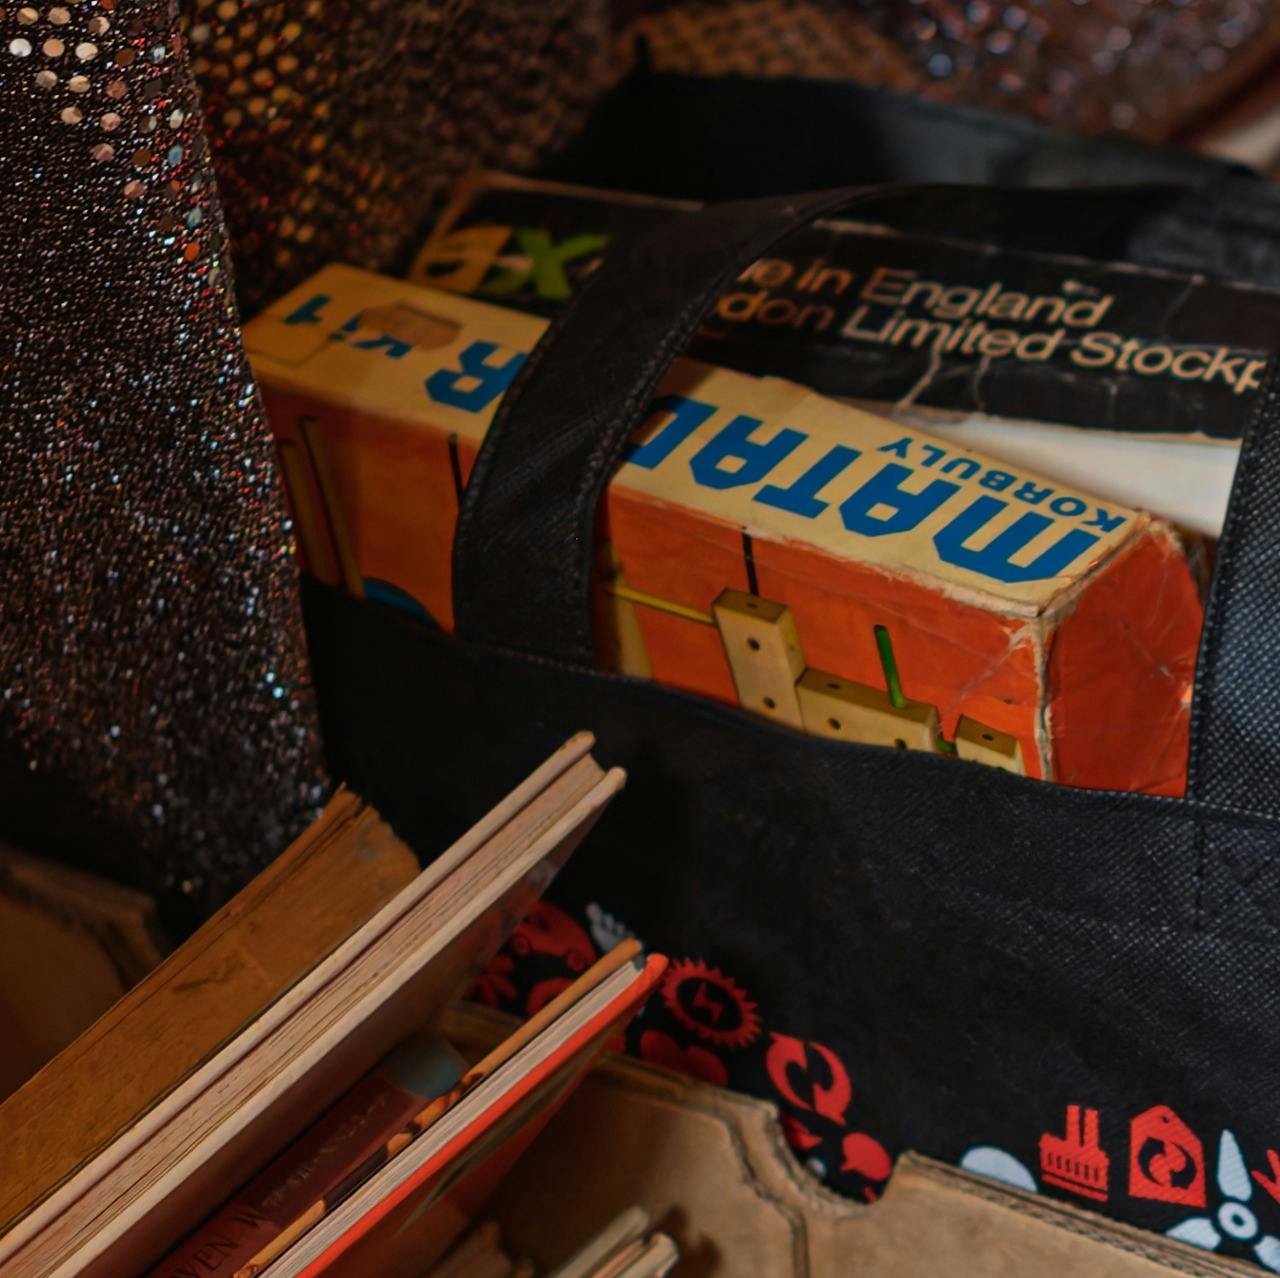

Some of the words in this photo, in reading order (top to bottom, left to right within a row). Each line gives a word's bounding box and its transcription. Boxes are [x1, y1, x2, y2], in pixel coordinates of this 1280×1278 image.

[795, 257, 853, 296] in
[860, 266, 1115, 328] England
[841, 303, 1066, 361] Limited
[879, 436, 1127, 534] KORBULY
